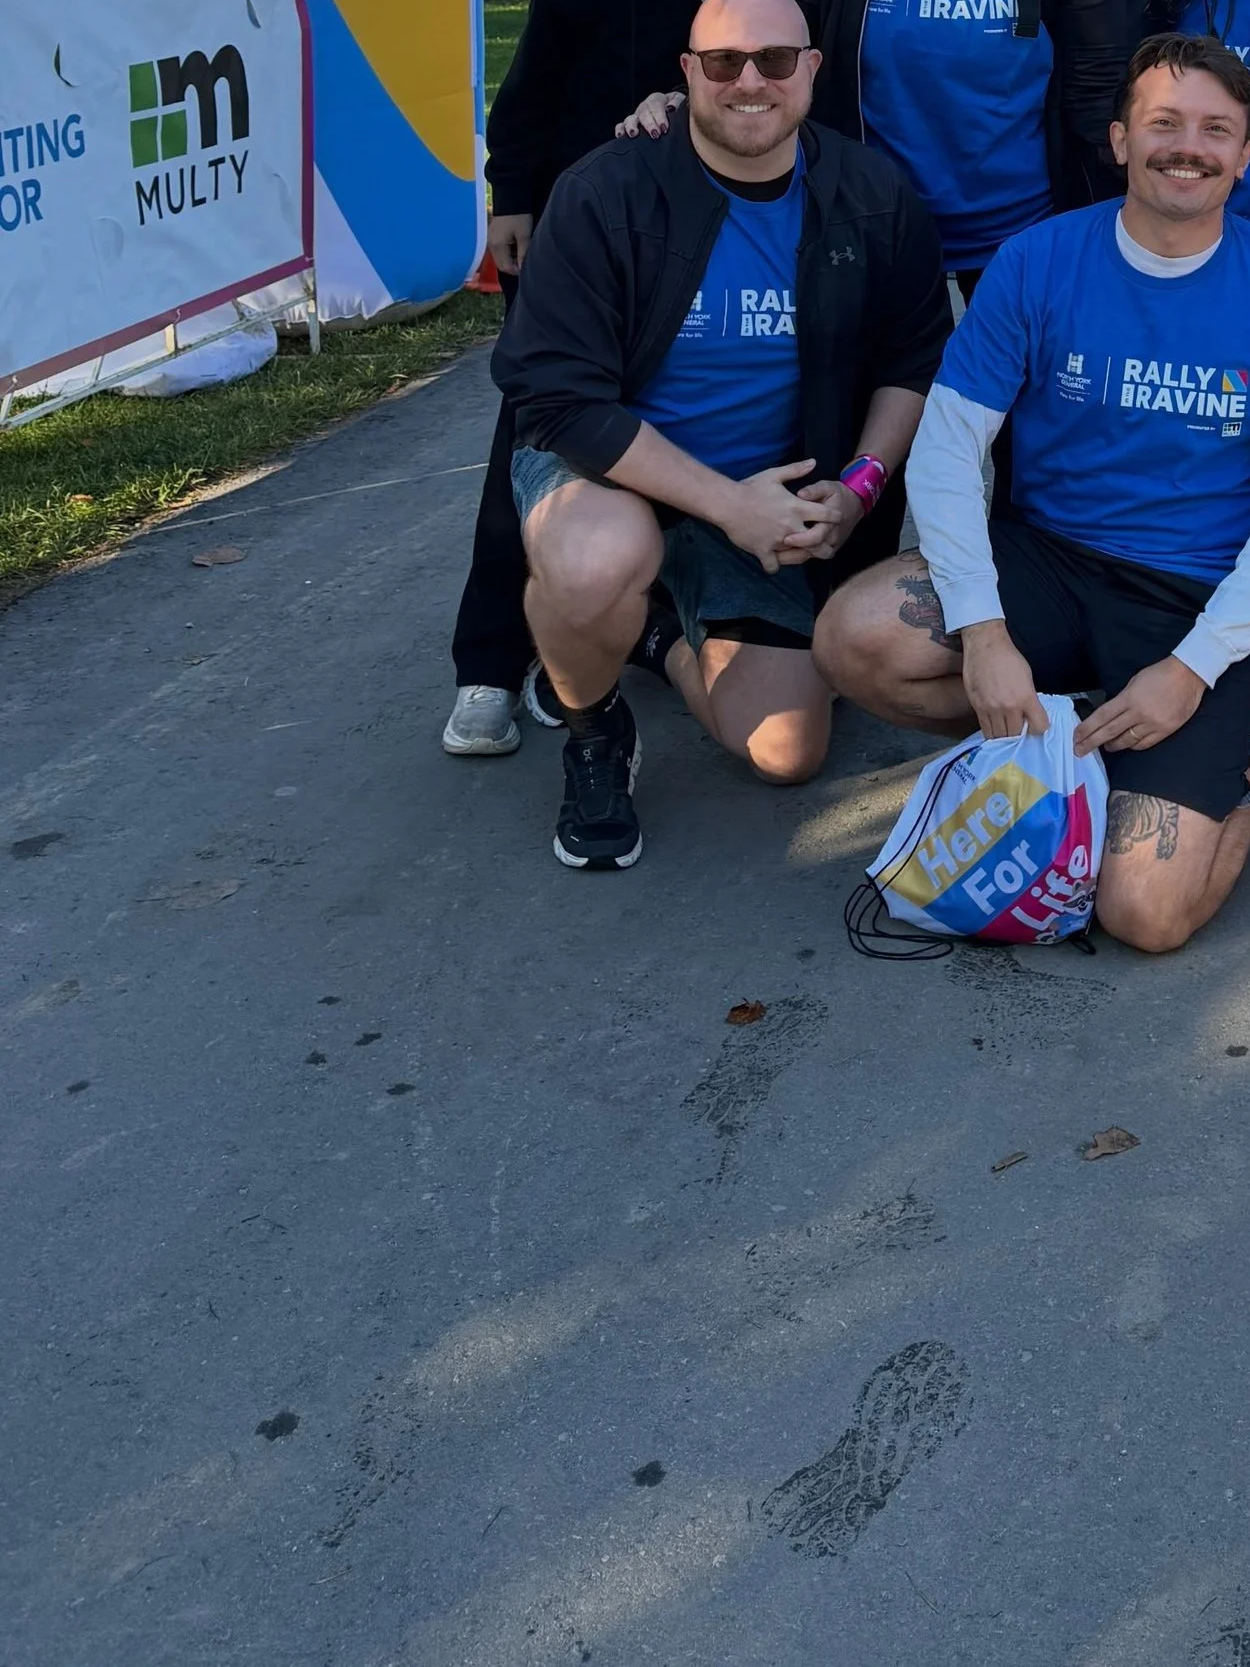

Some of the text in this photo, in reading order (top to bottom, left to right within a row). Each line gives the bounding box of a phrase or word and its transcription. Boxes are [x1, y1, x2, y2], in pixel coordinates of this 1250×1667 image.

[0, 113, 86, 177] TING
[134, 149, 250, 226] MULTY
[740, 289, 797, 313] RAL
[1123, 358, 1216, 391] RALLY
[1135, 384, 1247, 418] RAVINE
[916, 790, 1015, 891] Here
[961, 838, 1040, 916] For
[1010, 844, 1089, 931] Life
